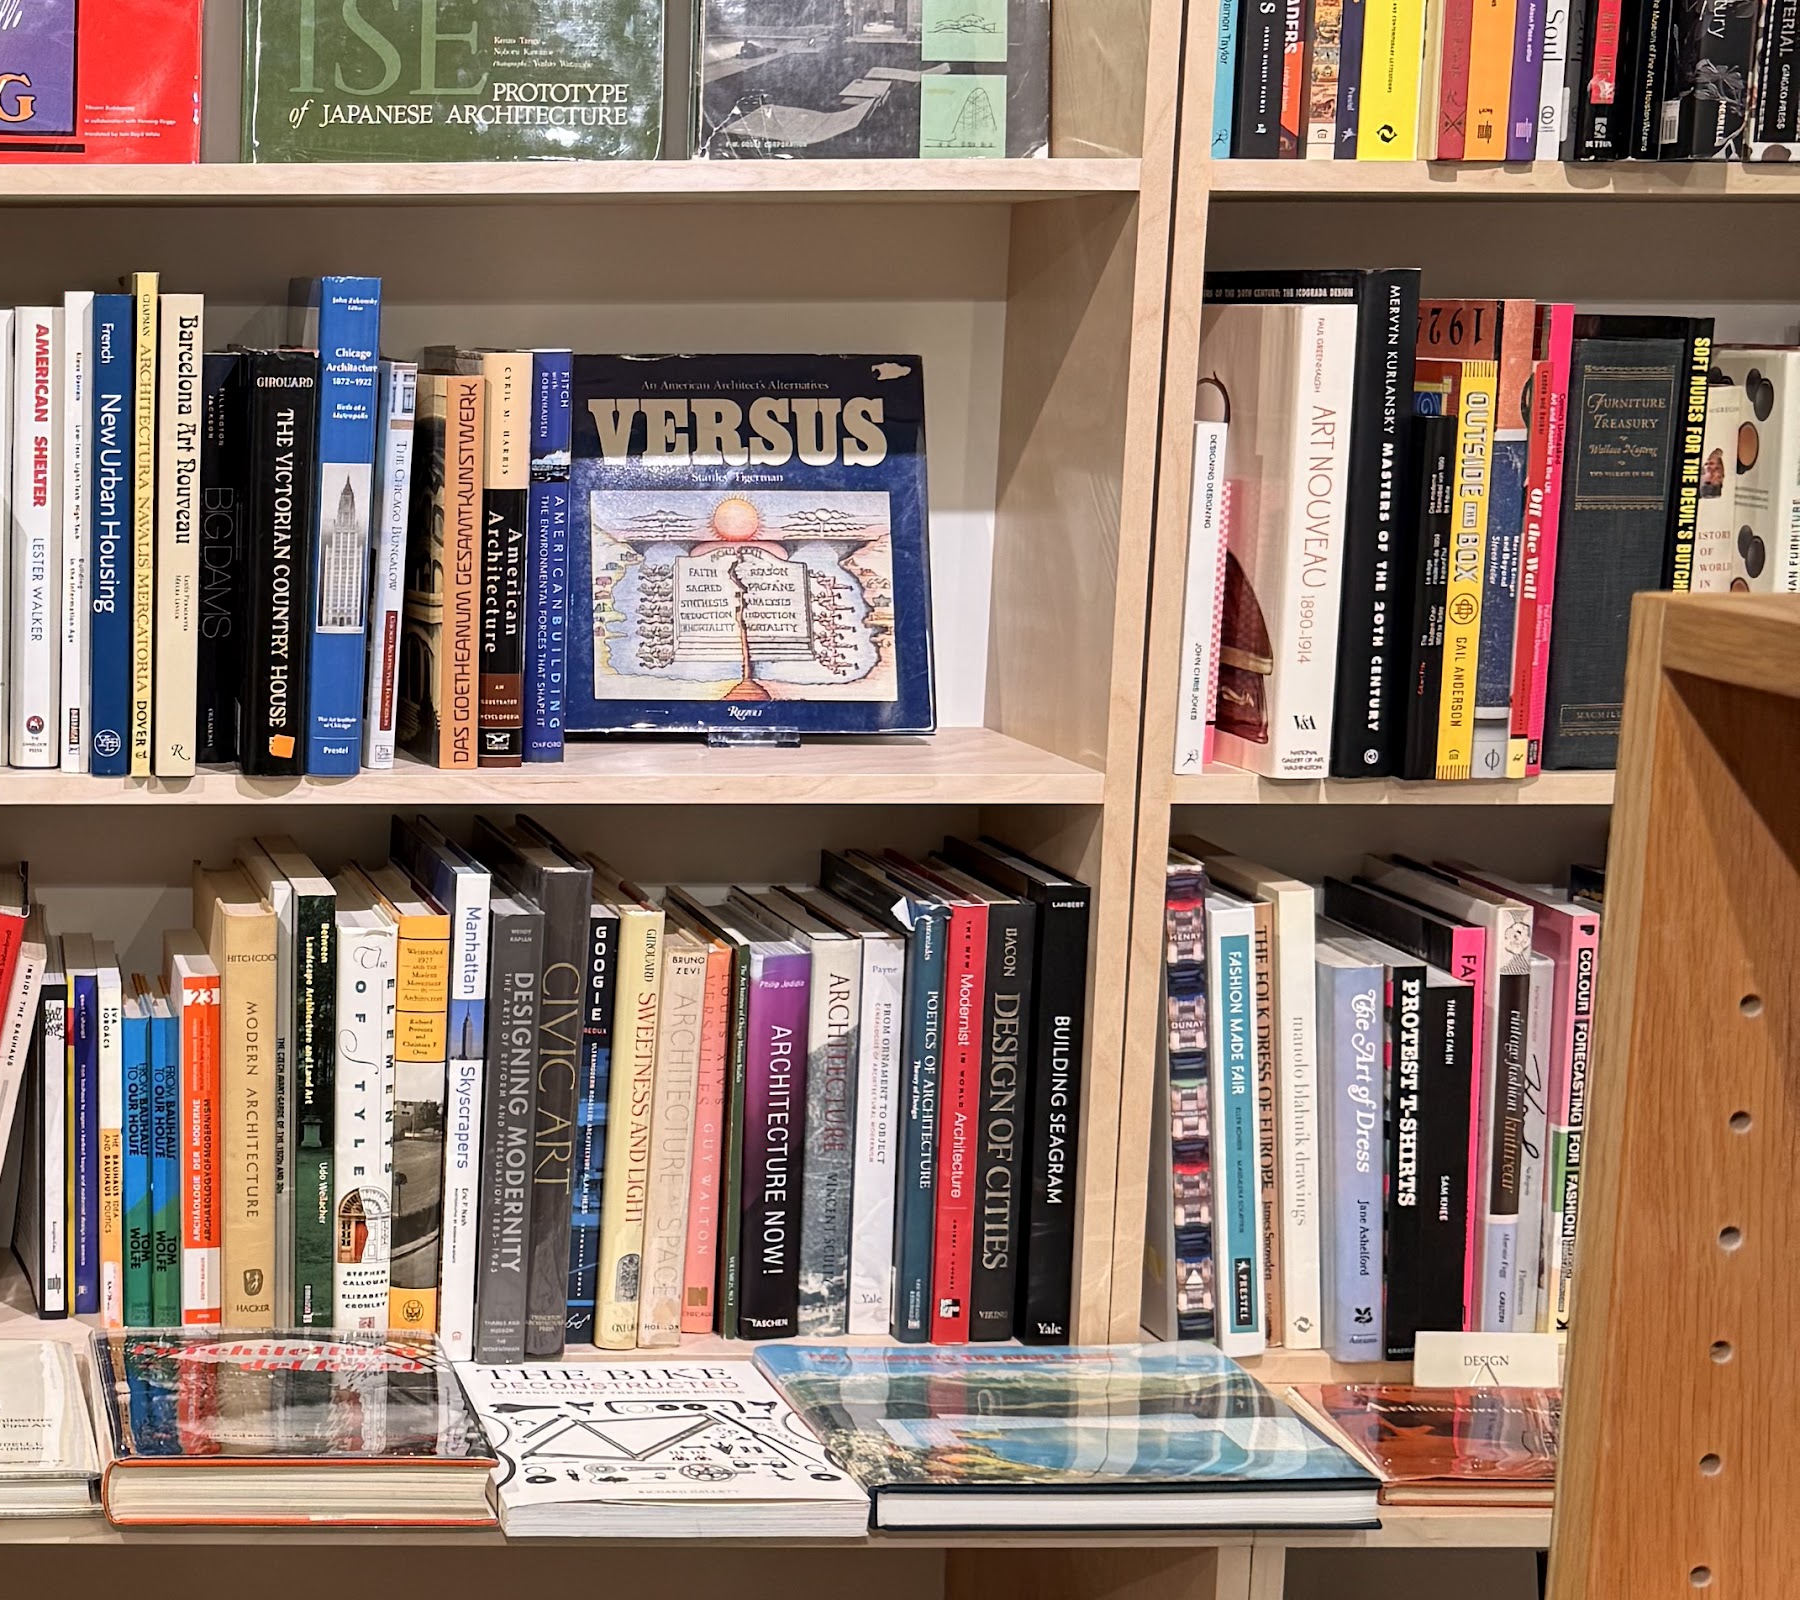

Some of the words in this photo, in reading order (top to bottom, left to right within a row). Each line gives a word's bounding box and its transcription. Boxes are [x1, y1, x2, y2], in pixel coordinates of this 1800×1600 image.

[288, 99, 313, 127] of
[321, 104, 434, 125] JAPANESE
[445, 104, 629, 126] ARCHITECTURE
[492, 82, 629, 103] PROTOTYPE
[34, 324, 49, 422] AMERICAN
[100, 323, 113, 364] French
[256, 374, 313, 390] GIROUARD
[588, 397, 886, 466] VERSUS
[1459, 392, 1489, 500] OUTSIDE
[33, 437, 47, 508] SHELTER
[1461, 502, 1475, 528] THE
[688, 567, 718, 578] FAITH
[750, 567, 788, 578] REASON
[1454, 531, 1478, 583] BOX
[685, 583, 723, 593] SACRED
[1455, 638, 1467, 661] GAIL
[1450, 667, 1464, 727] ANDERSON
[465, 907, 483, 993] Manhattan
[1228, 951, 1242, 1013] FASHION
[540, 963, 579, 1091] CIVIC
[1230, 1019, 1243, 1061] MADE
[1399, 980, 1419, 1088] PROTEST
[1050, 1015, 1070, 1108] BUILDING
[1231, 1064, 1245, 1093] FAIR
[456, 1067, 475, 1169] Skyscrapers
[766, 1025, 791, 1201] ARCHITECTURE
[534, 1108, 572, 1196] ART
[1047, 1113, 1067, 1203] SEAGRAM
[1396, 1097, 1418, 1206] T-SHIRTS
[763, 1211, 784, 1275] NOW!
[1037, 1321, 1063, 1335] Yale
[476, 1367, 593, 1381] THE
[608, 1366, 730, 1381] BIKE
[1463, 1355, 1509, 1366] DESIGN
